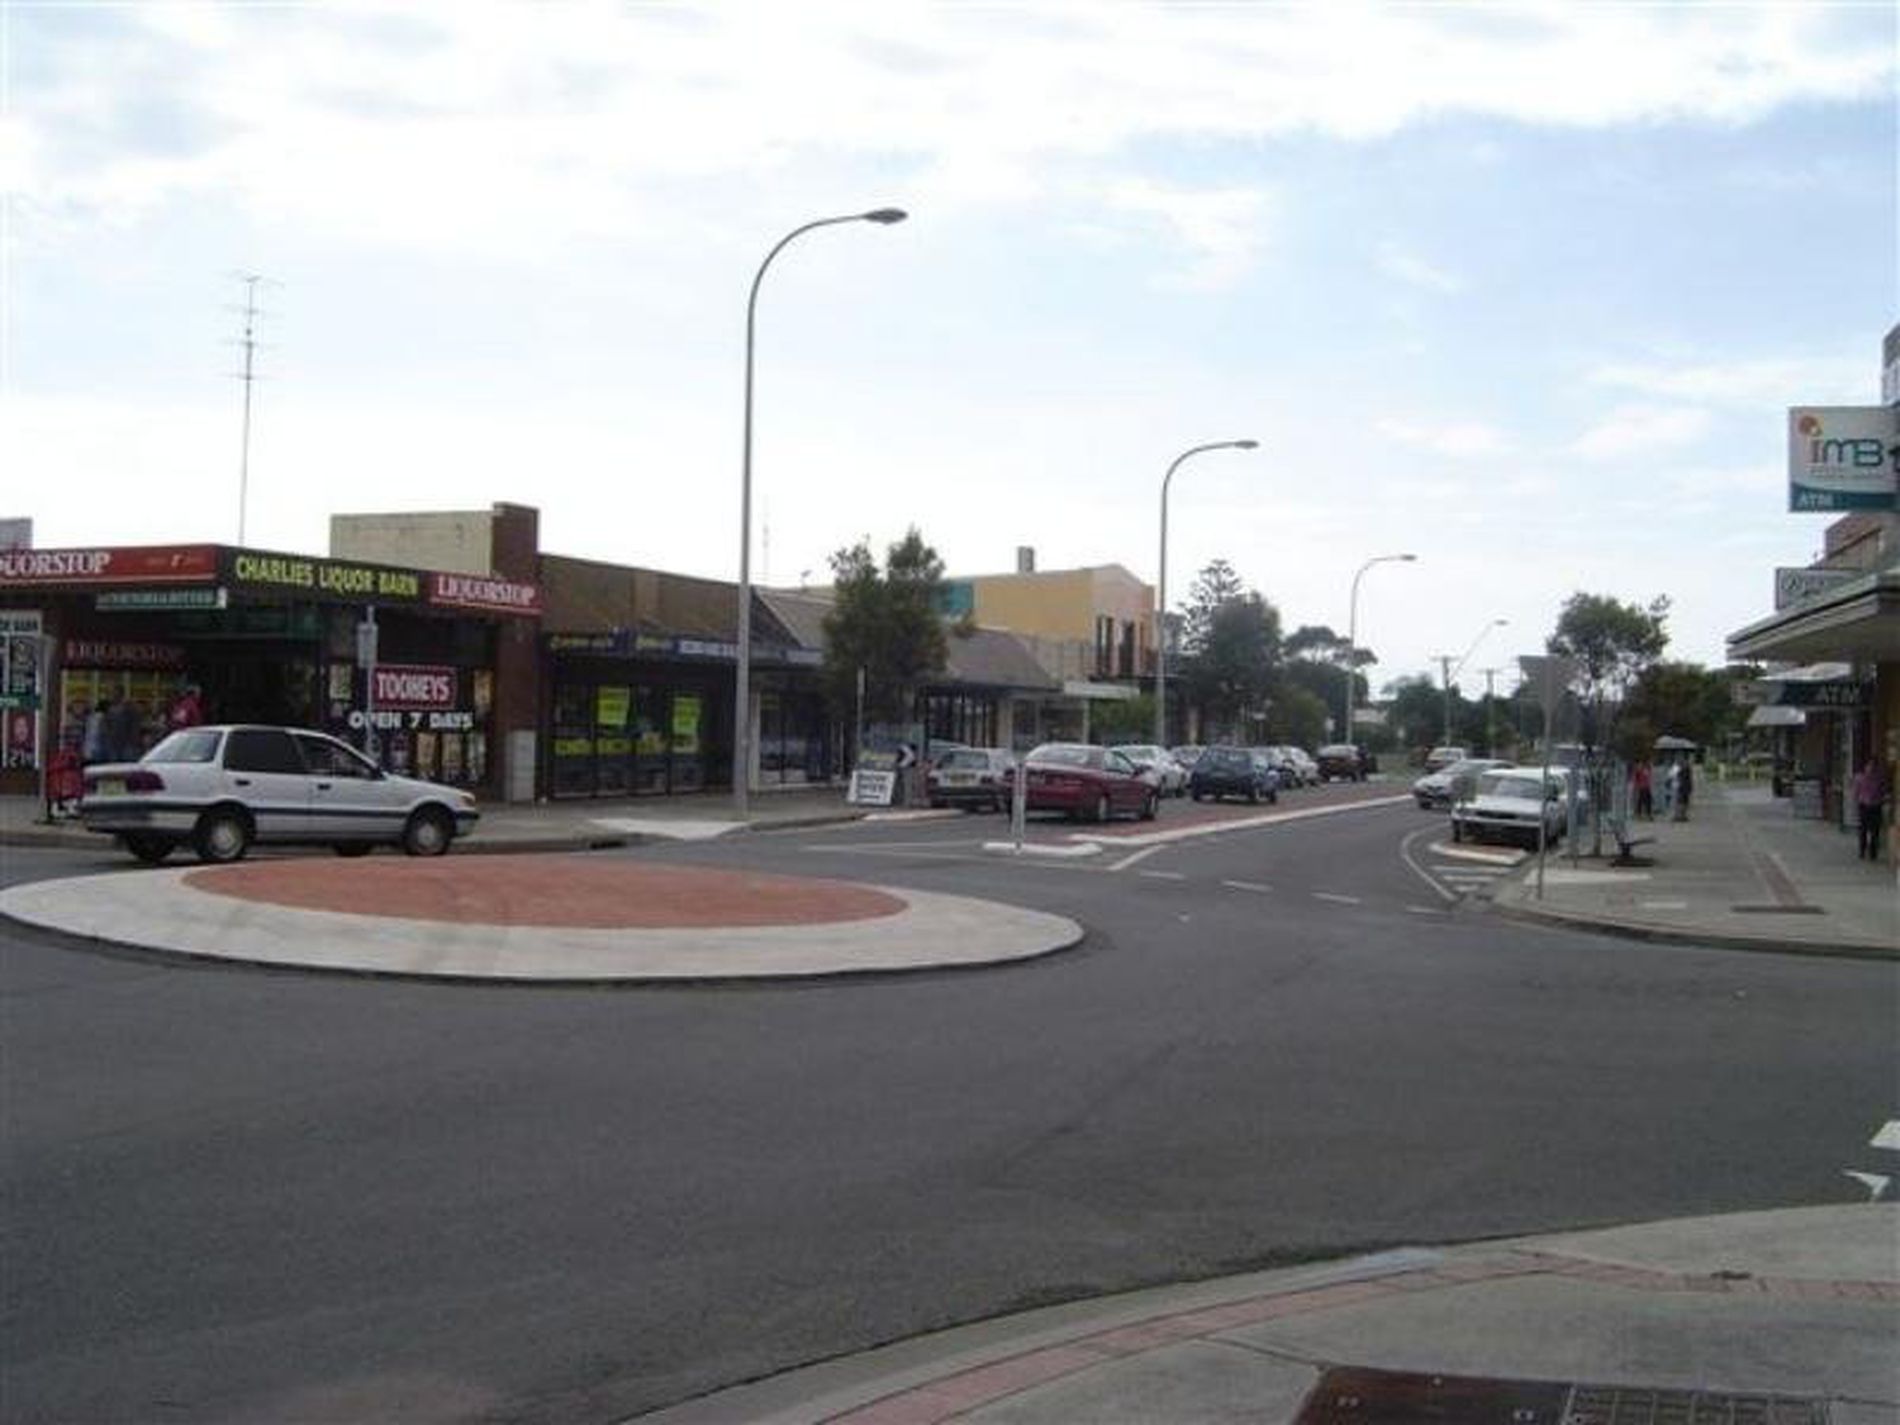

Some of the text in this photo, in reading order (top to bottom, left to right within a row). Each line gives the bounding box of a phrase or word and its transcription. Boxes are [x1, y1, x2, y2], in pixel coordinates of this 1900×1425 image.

[0, 552, 111, 577] UORSTOP
[235, 556, 314, 587] CHARLIES
[319, 566, 373, 594] LIQUOR
[379, 571, 419, 595] BARN
[437, 574, 536, 606] LIQUORSTOP
[376, 671, 449, 701] TOOHEYS
[349, 711, 473, 728] OPEN 7 DAYS
